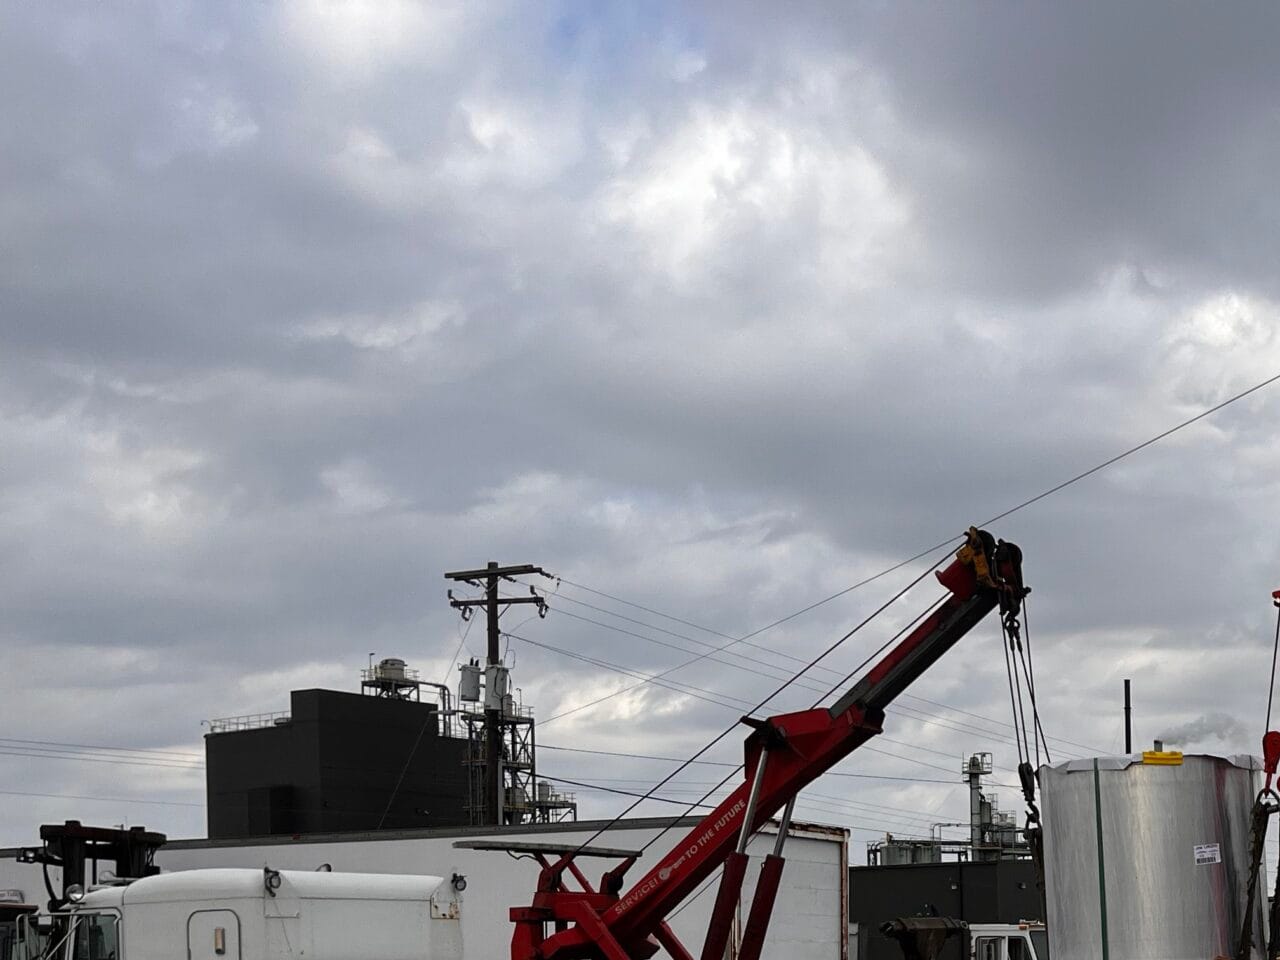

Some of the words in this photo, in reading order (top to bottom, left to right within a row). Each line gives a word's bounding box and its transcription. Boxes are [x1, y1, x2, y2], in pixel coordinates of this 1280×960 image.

[685, 845, 699, 859] TO
[698, 829, 716, 847] THE
[713, 799, 746, 832] FUTURE
